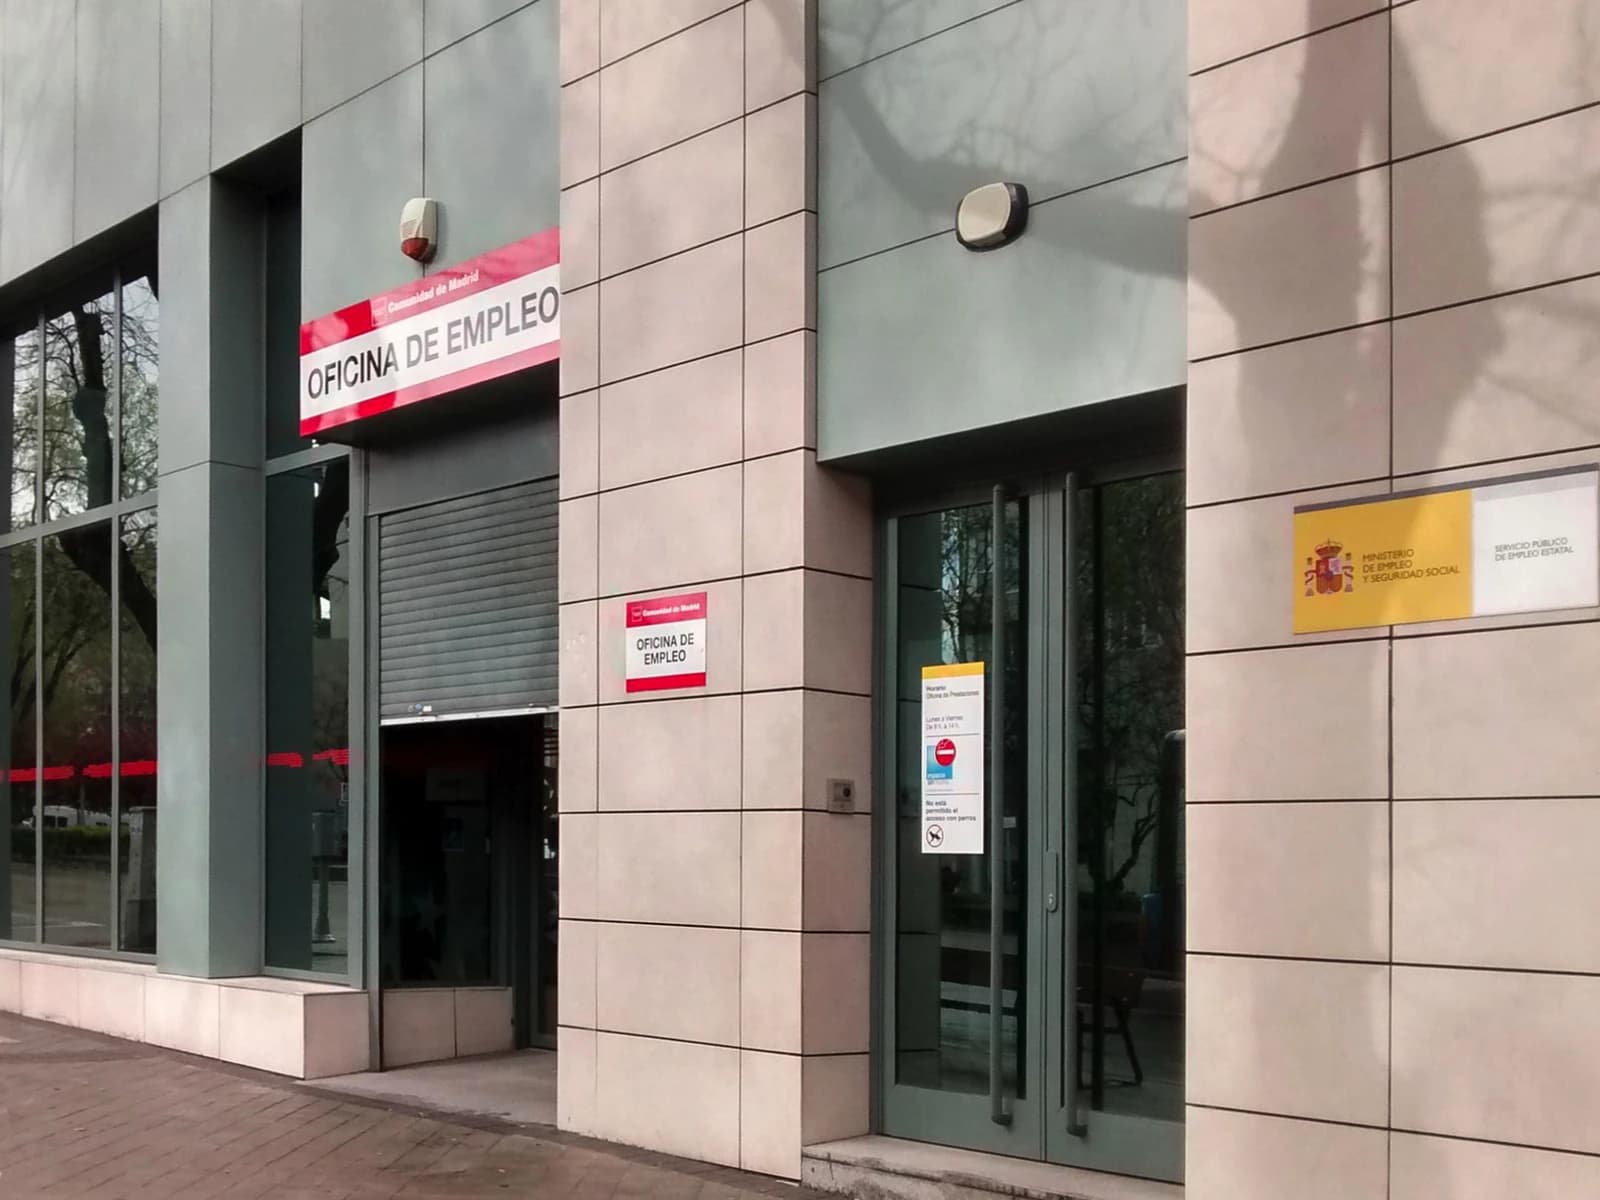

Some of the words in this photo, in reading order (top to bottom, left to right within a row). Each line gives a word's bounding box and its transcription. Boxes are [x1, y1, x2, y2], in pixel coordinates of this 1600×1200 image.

[387, 287, 434, 313] Comunidad
[436, 282, 447, 295] de
[448, 269, 479, 291] Madrid
[307, 343, 399, 399] OFICINA
[406, 327, 439, 368] DE
[447, 286, 559, 355] EMPLEO
[1495, 542, 1530, 552] SERVICIO
[1508, 550, 1539, 560] EMPLEO
[1541, 546, 1574, 556] ESTATAL
[1362, 549, 1414, 562] MINISTERIO
[1362, 564, 1375, 573] DE
[1377, 560, 1413, 572] EMPLEO
[1370, 570, 1424, 583] SEGURIDAD
[1426, 565, 1461, 577] SOCIAL
[642, 606, 672, 616] Comunidad
[680, 602, 700, 612] Madrid
[636, 635, 677, 651] OFICINA
[680, 633, 694, 646] DE
[644, 649, 686, 665] EMPLEO
